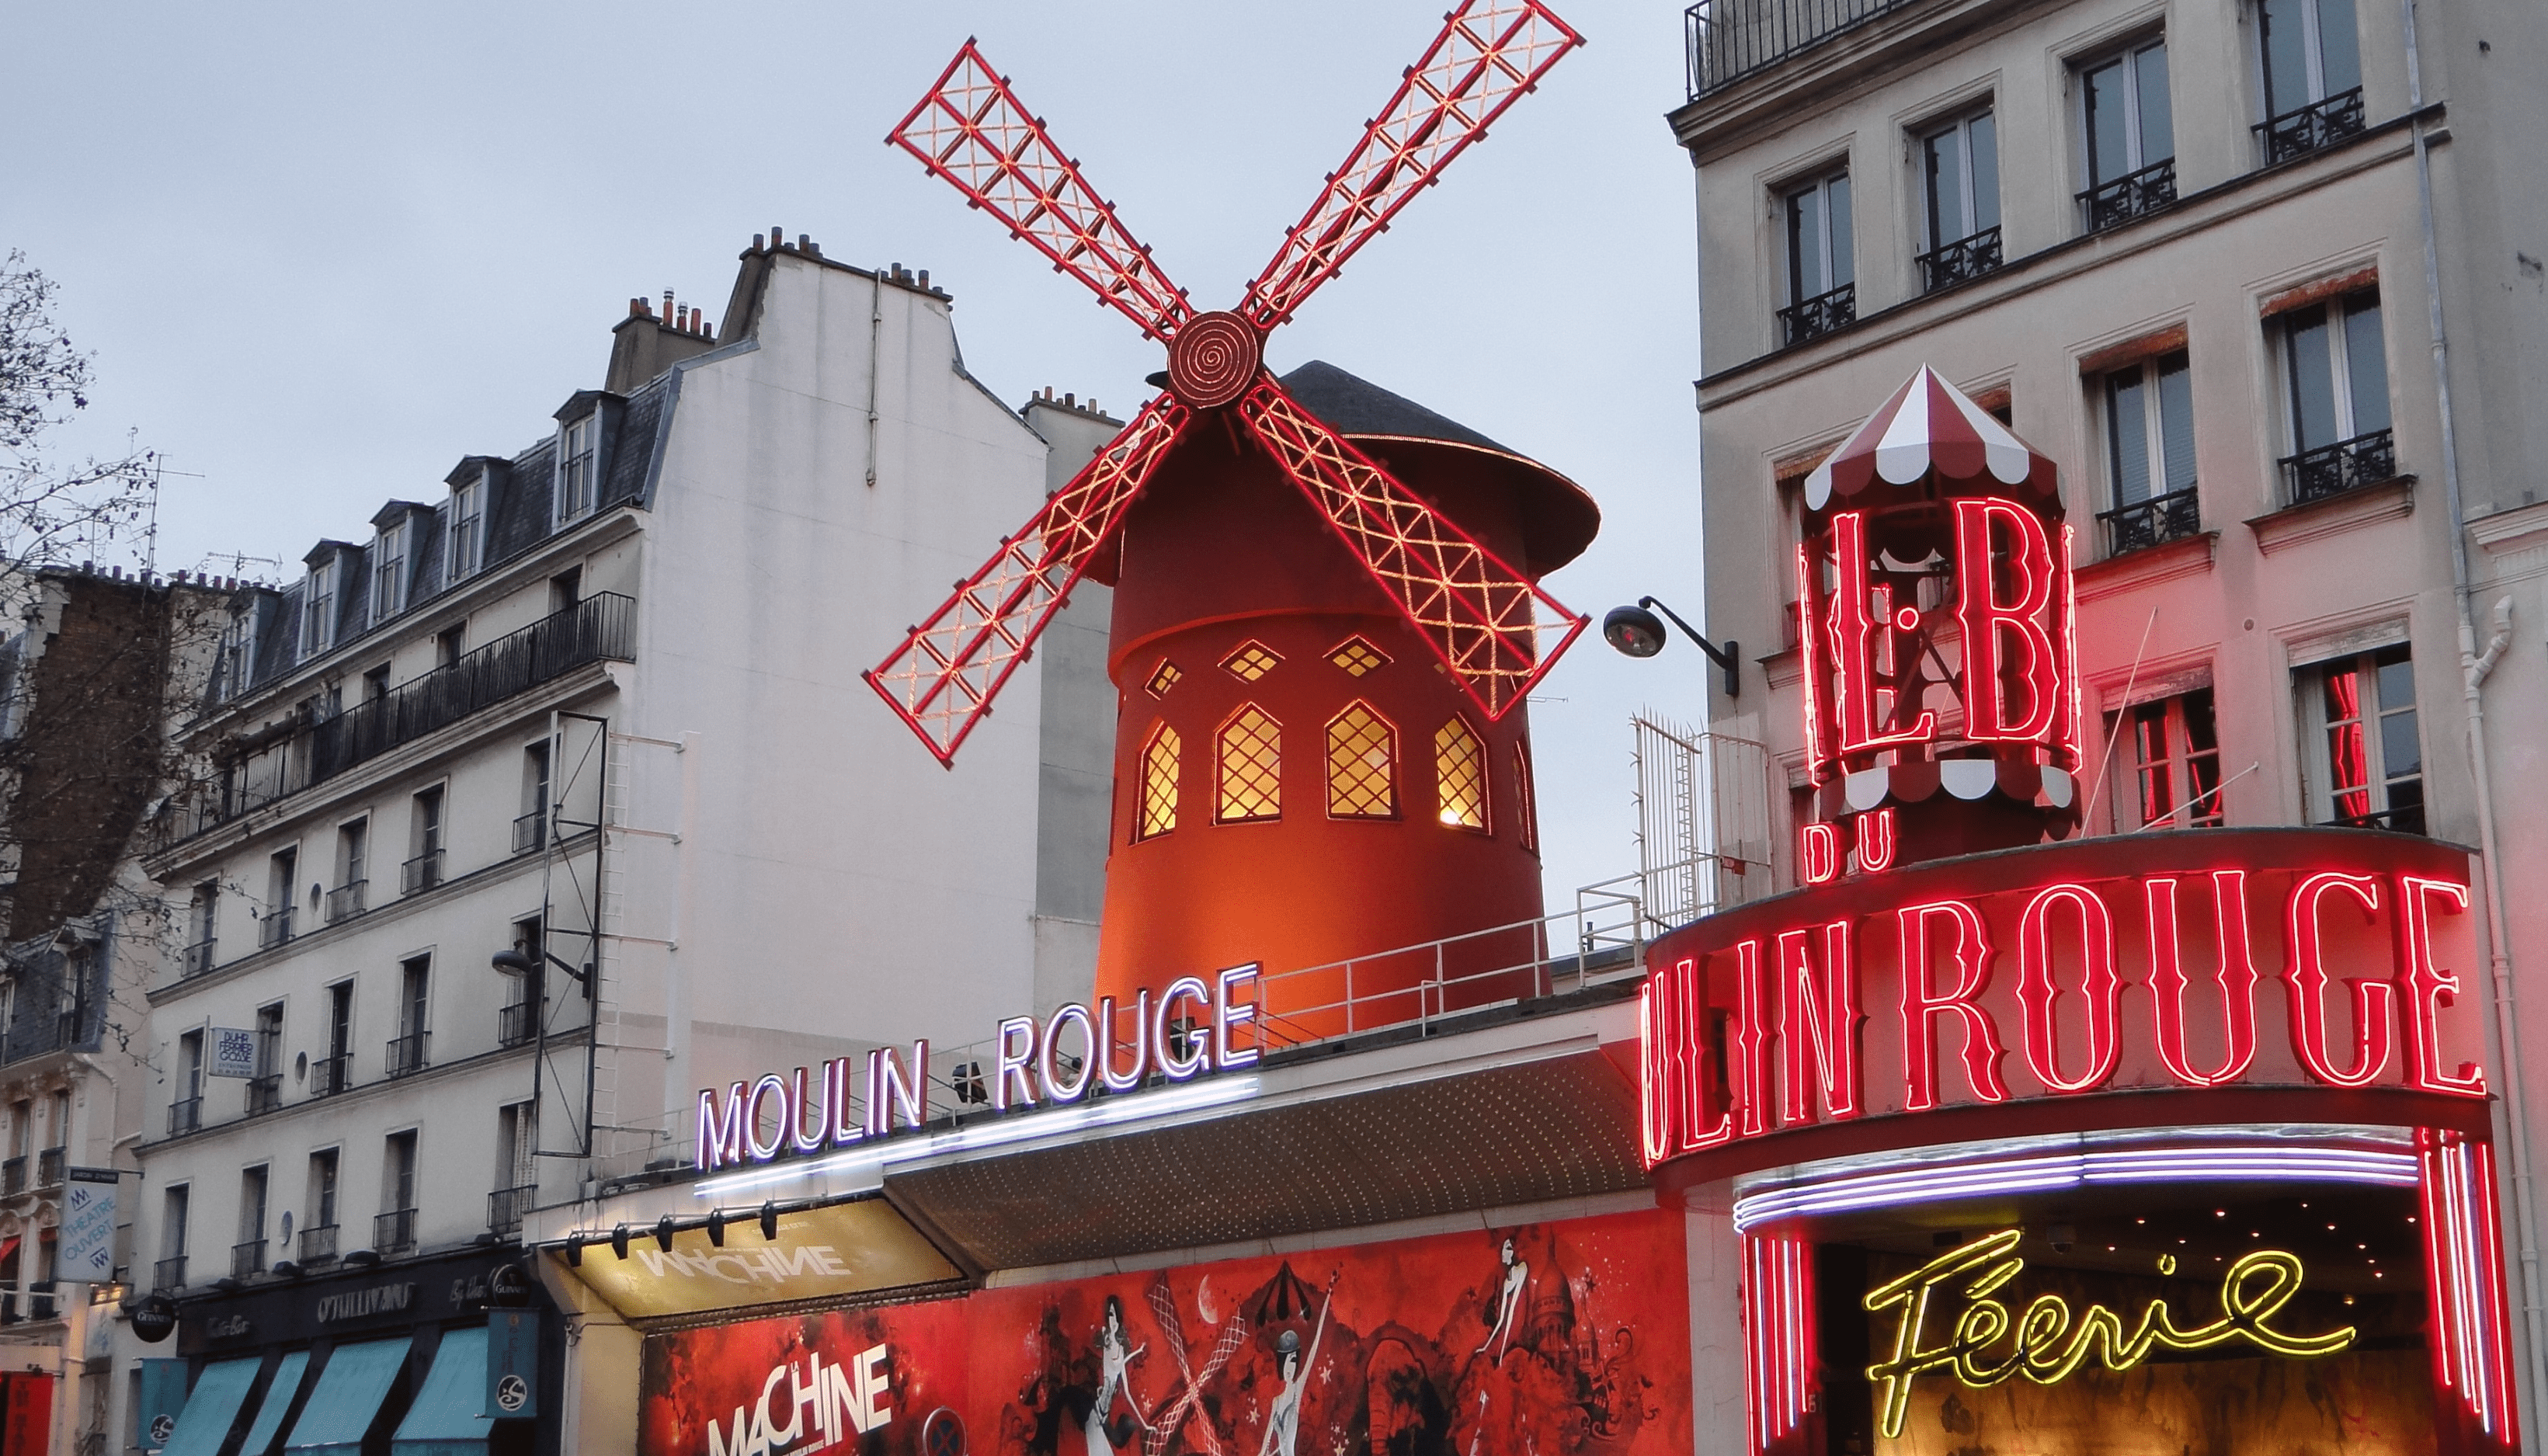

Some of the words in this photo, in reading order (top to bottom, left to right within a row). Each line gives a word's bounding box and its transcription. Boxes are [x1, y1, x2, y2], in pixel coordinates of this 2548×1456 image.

[1802, 810, 1892, 884] DU
[697, 1039, 929, 1170] MOULIN
[996, 959, 1264, 1110] ROUGE
[1639, 920, 1853, 1171] ULIN
[1898, 868, 2487, 1112] ROUGE
[64, 1218, 113, 1260] OUVERT
[707, 1343, 892, 1456] MACHINE
[1863, 1228, 2356, 1440] Féerie
